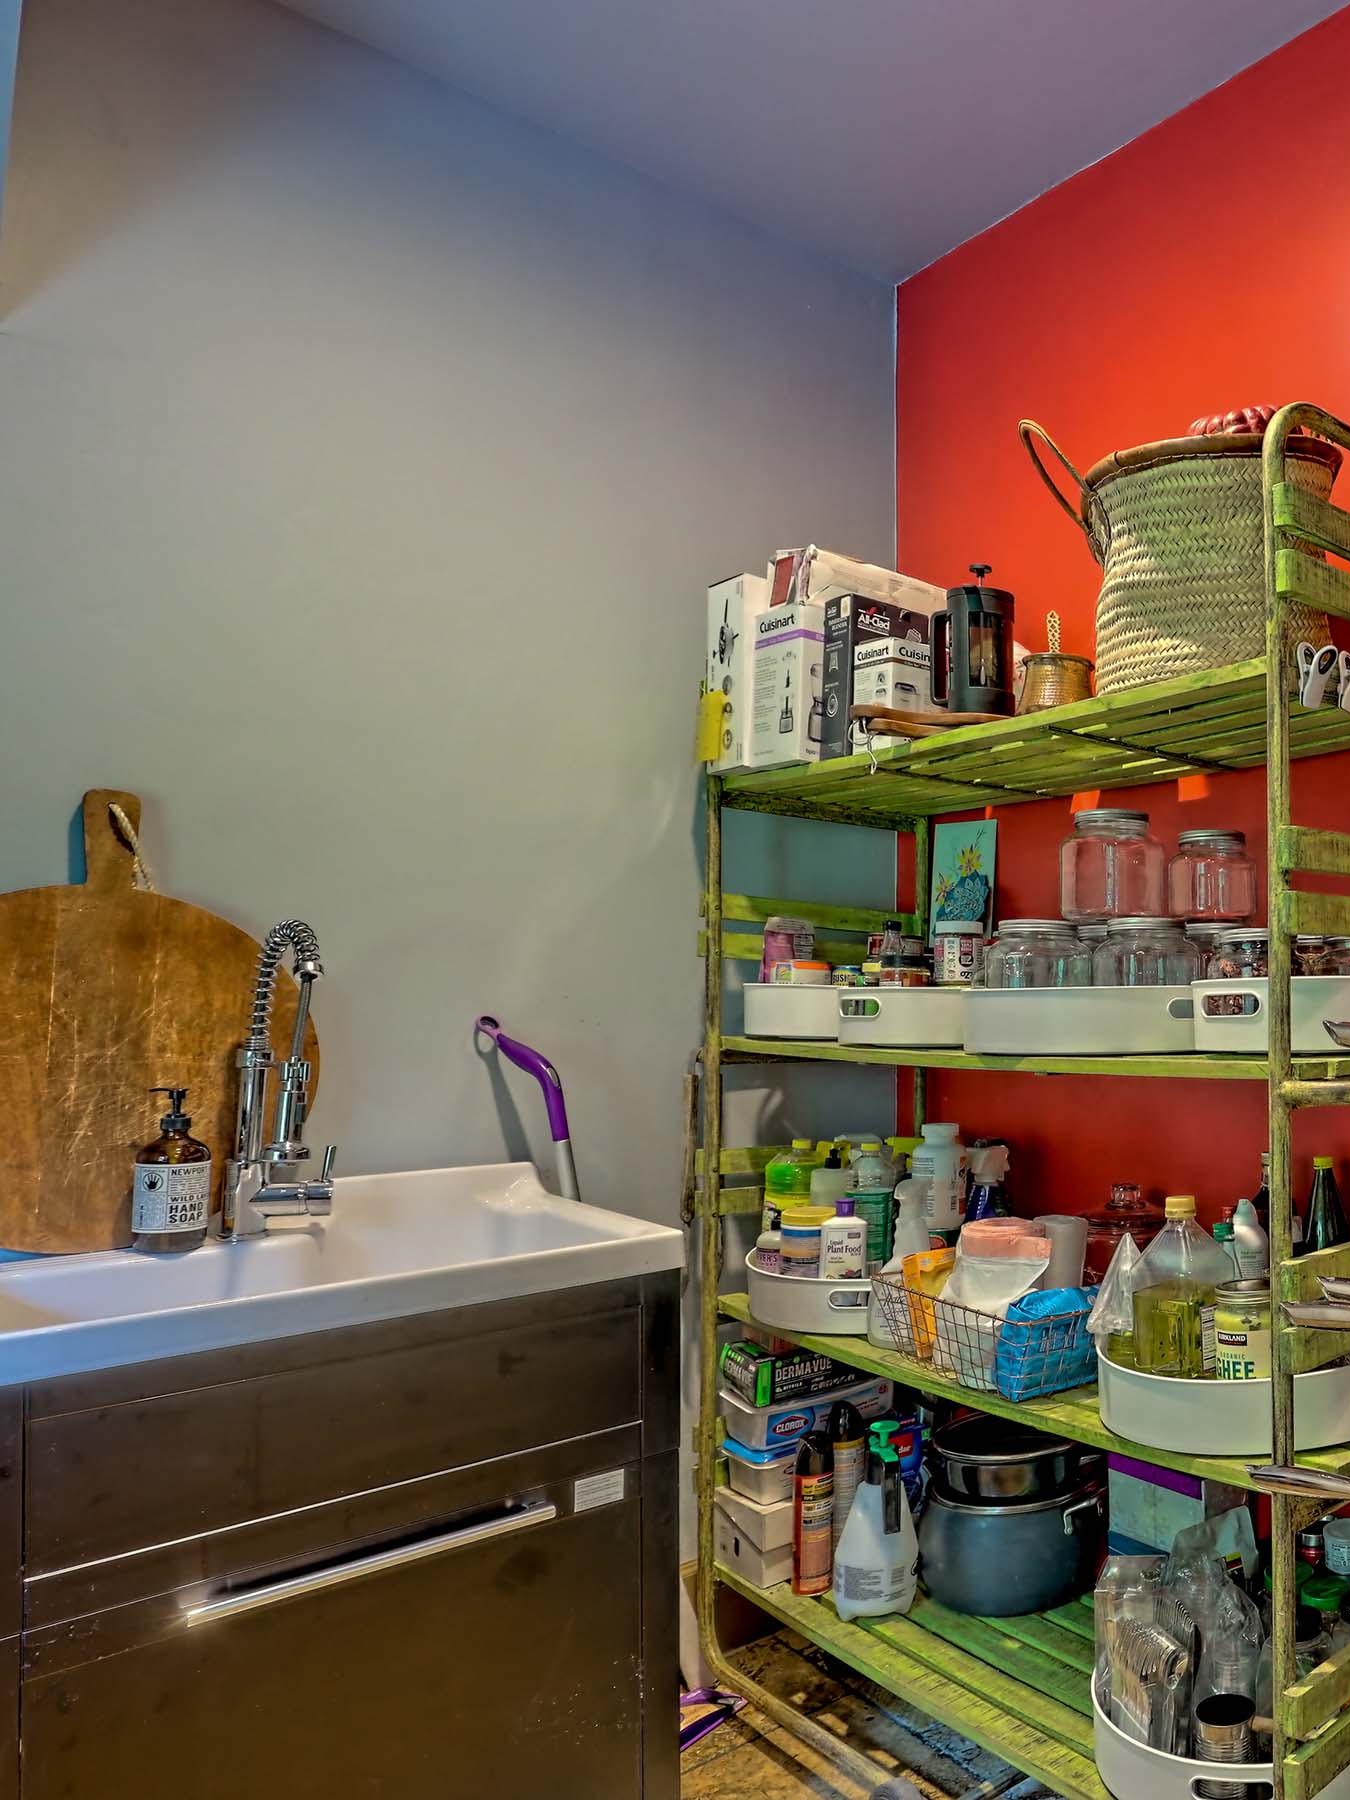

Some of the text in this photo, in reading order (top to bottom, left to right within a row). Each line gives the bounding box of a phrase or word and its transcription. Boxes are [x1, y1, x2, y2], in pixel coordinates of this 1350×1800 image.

[760, 614, 795, 633] Cuisinart
[858, 613, 890, 630] All-Clad
[857, 646, 889, 661] Cuisinart
[170, 1195, 195, 1203] WILD
[169, 1202, 204, 1214] HAND
[168, 1211, 203, 1224] SOAP
[827, 1244, 862, 1254] Plant Food
[775, 1357, 833, 1382] DERMA-VUE
[1216, 1357, 1257, 1380] GHEE
[776, 1418, 806, 1433] CLOROX
